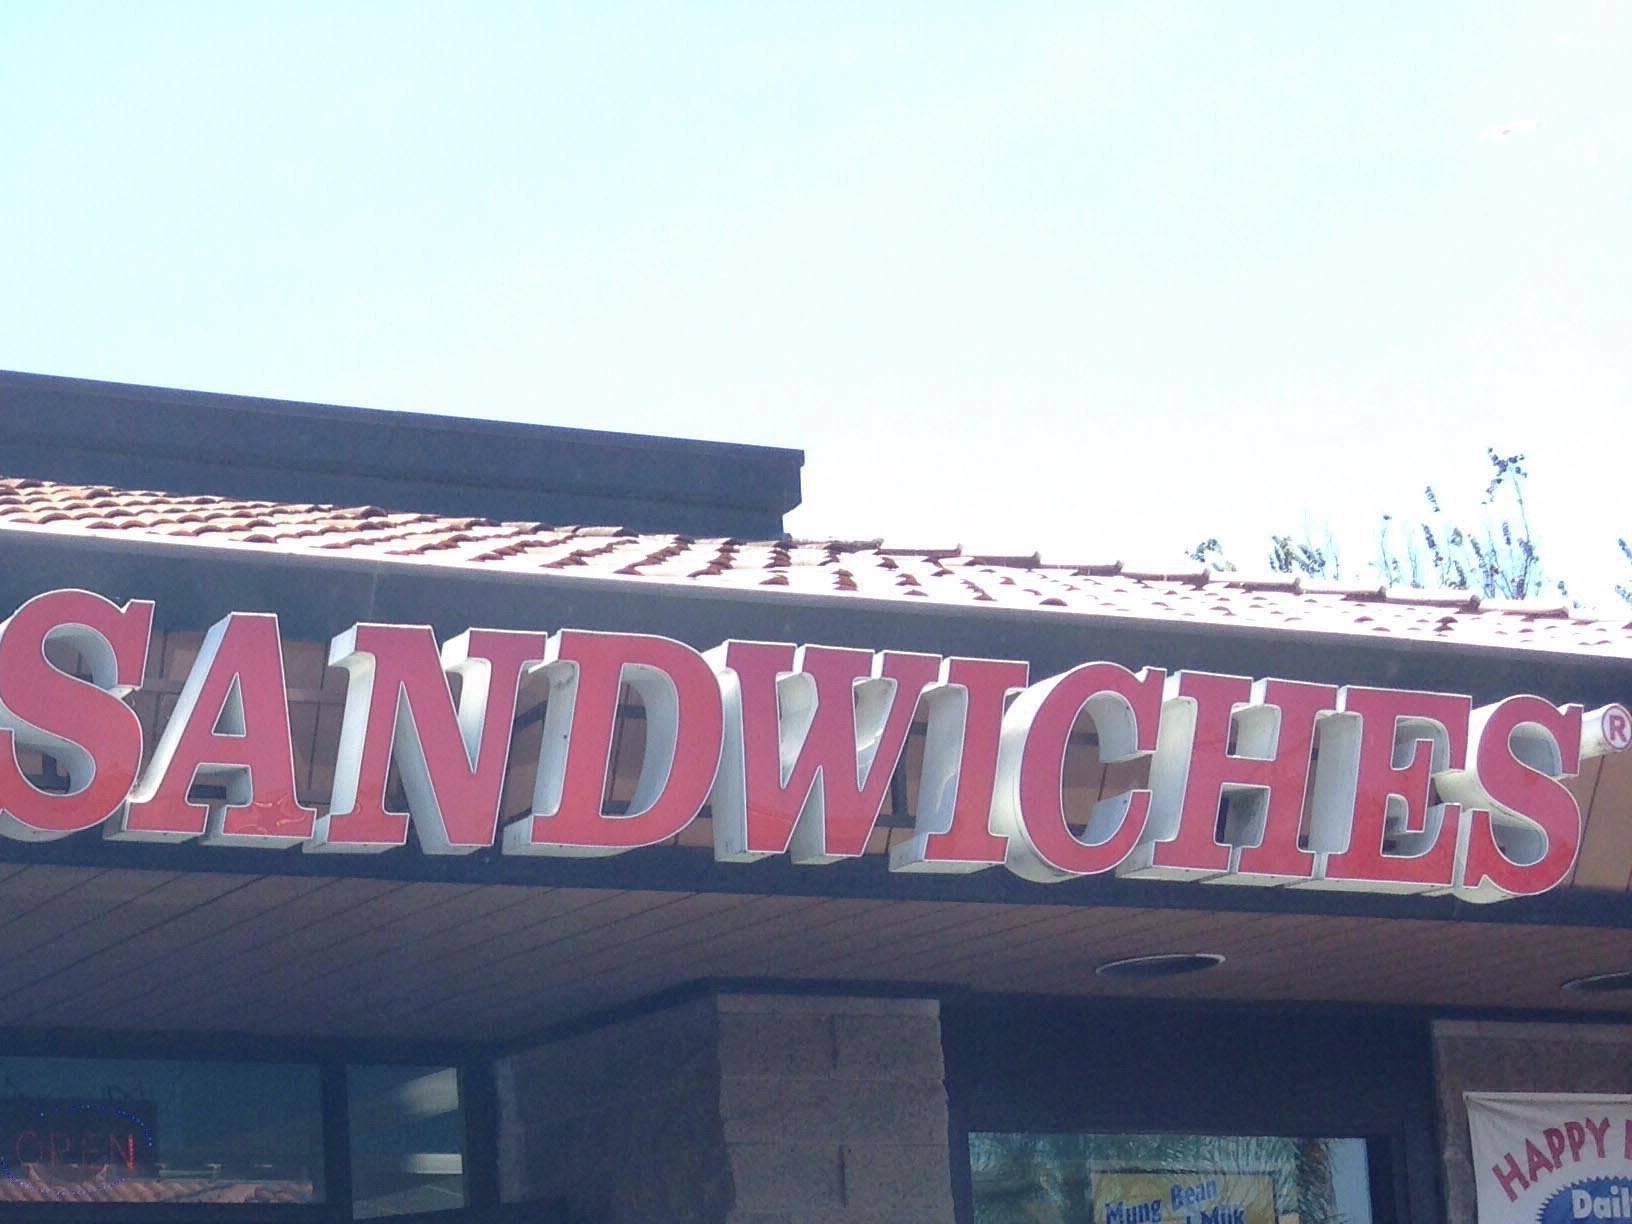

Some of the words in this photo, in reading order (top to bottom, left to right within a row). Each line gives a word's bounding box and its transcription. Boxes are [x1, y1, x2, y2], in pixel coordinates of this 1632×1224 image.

[1492, 1116, 1611, 1203] HAPPY
[1170, 1178, 1218, 1210] Bean
[1571, 1185, 1632, 1220] Dail
